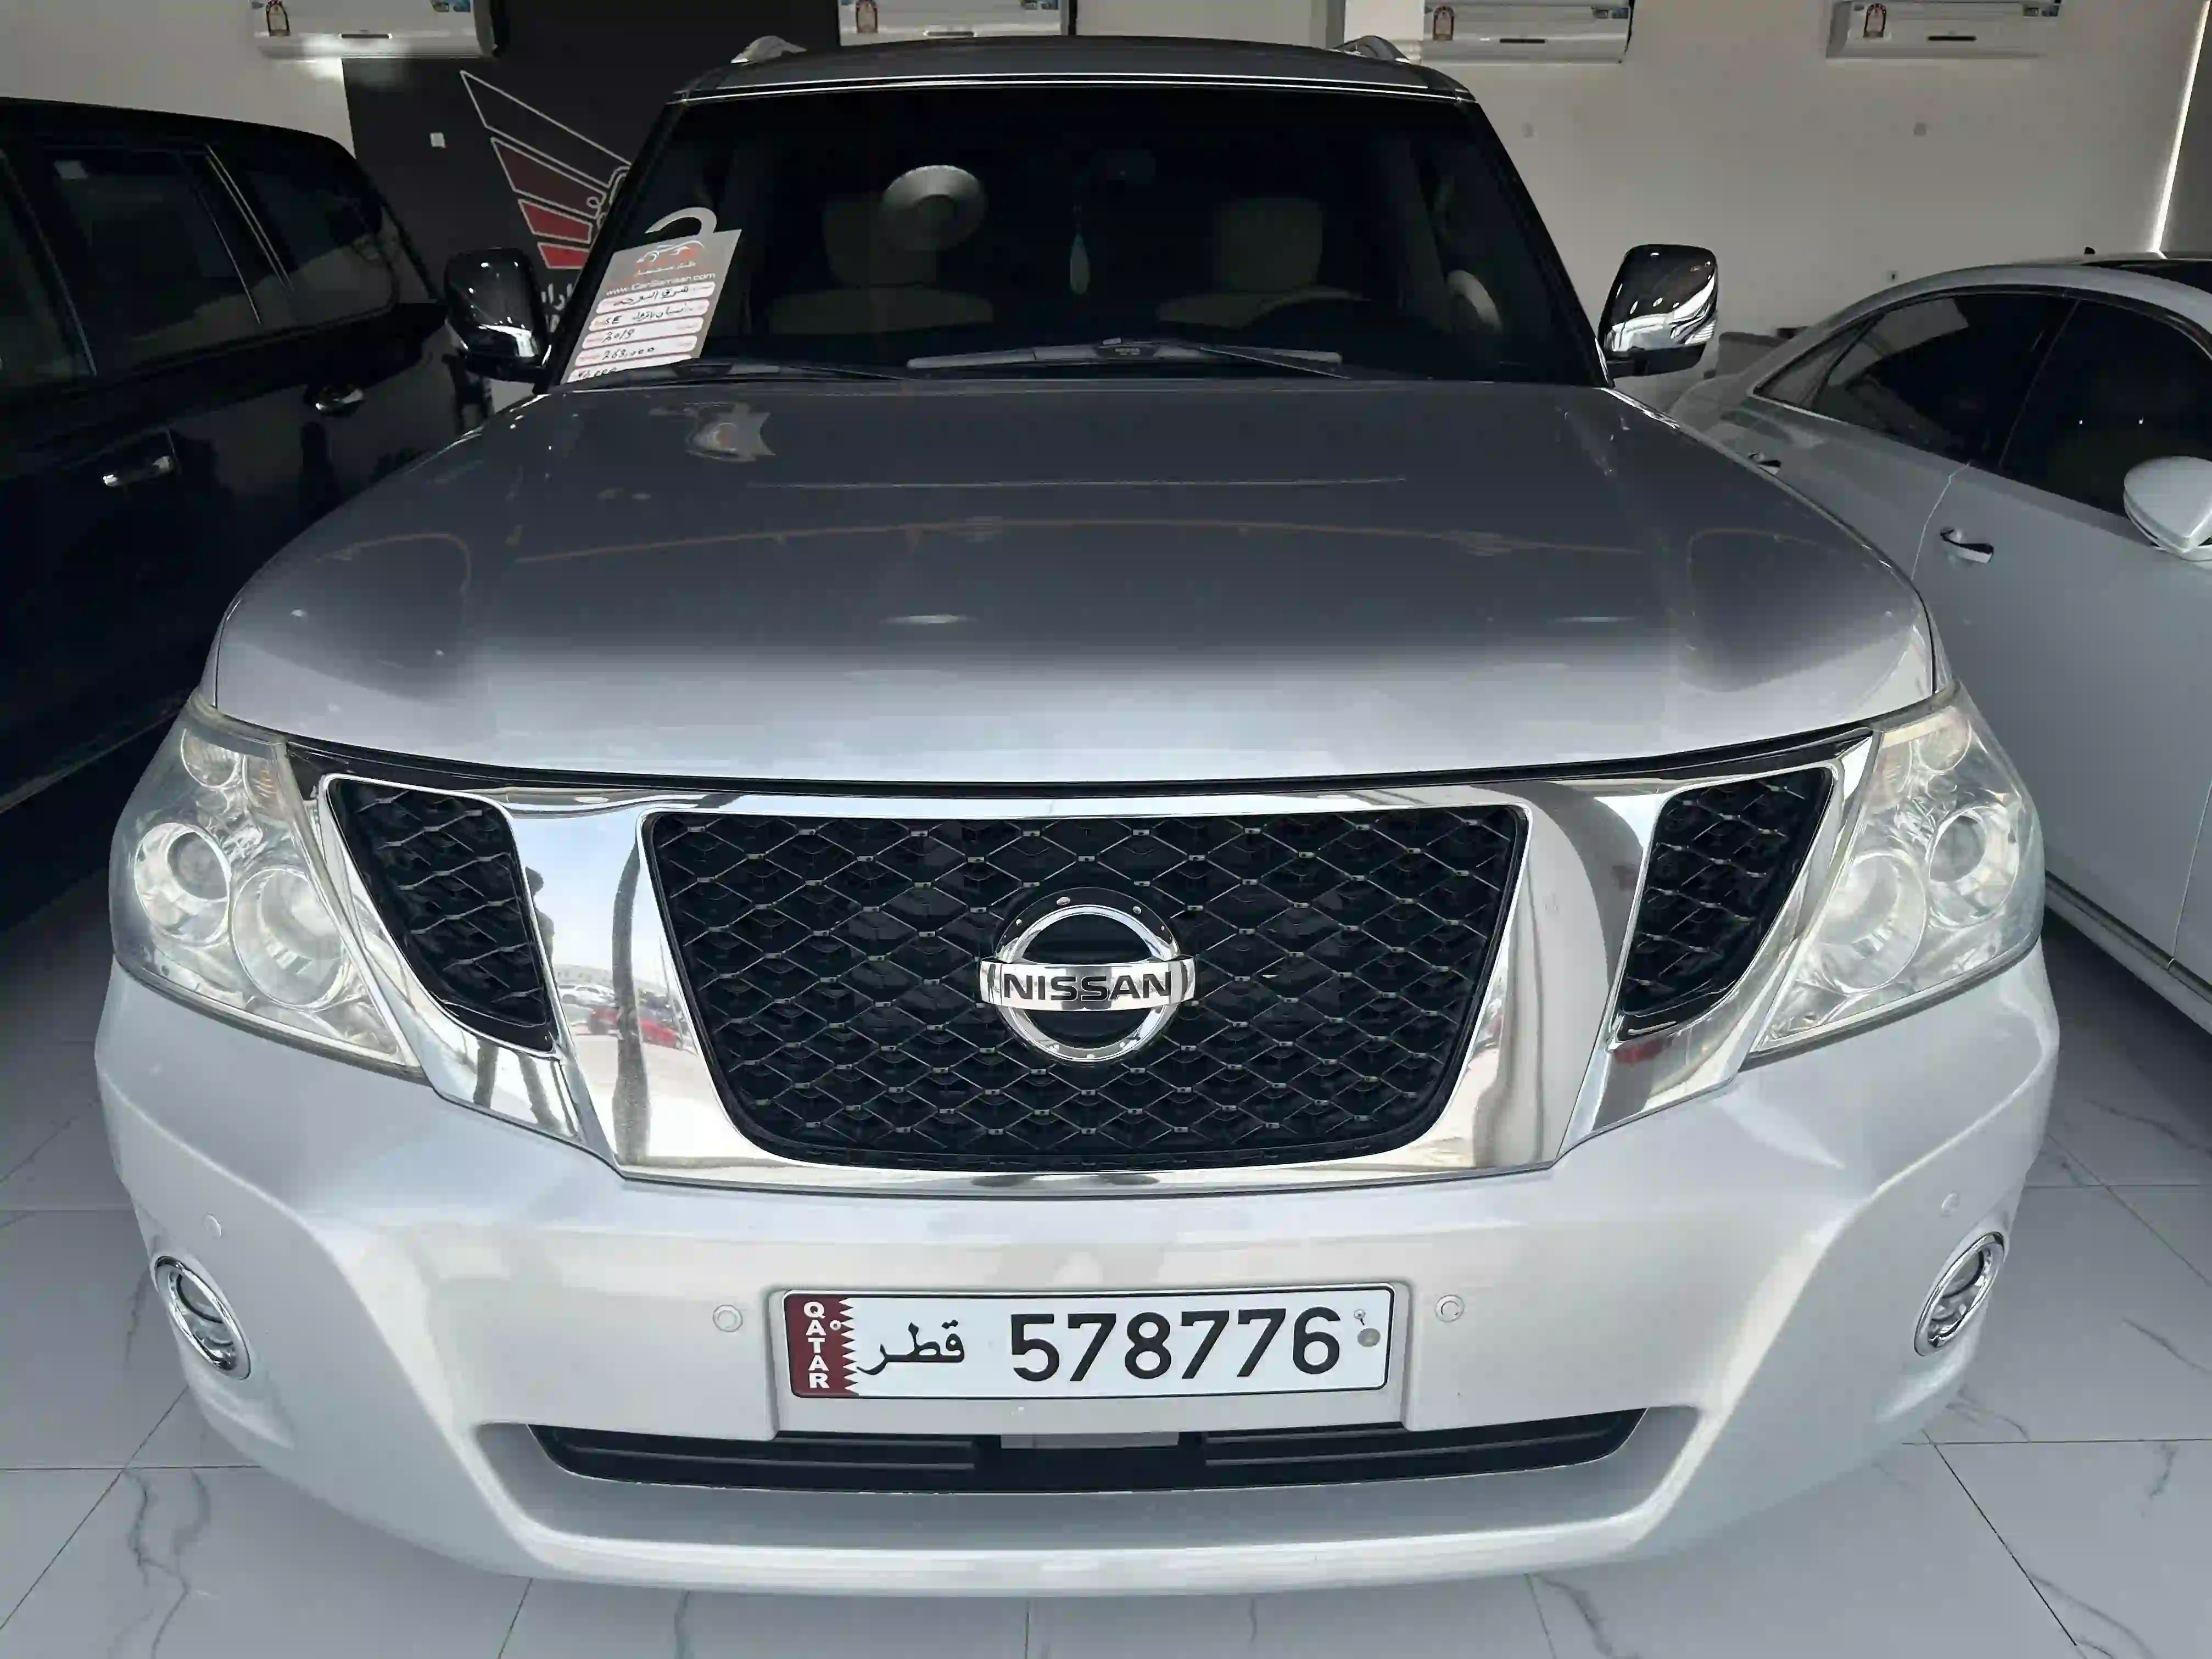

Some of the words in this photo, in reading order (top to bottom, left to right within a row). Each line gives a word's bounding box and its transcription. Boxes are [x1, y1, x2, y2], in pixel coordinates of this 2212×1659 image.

[1003, 971, 1172, 1002] NISSAN
[803, 1300, 830, 1389] QATAR
[856, 1319, 965, 1376] قطر
[1010, 1305, 1342, 1382] 578776
